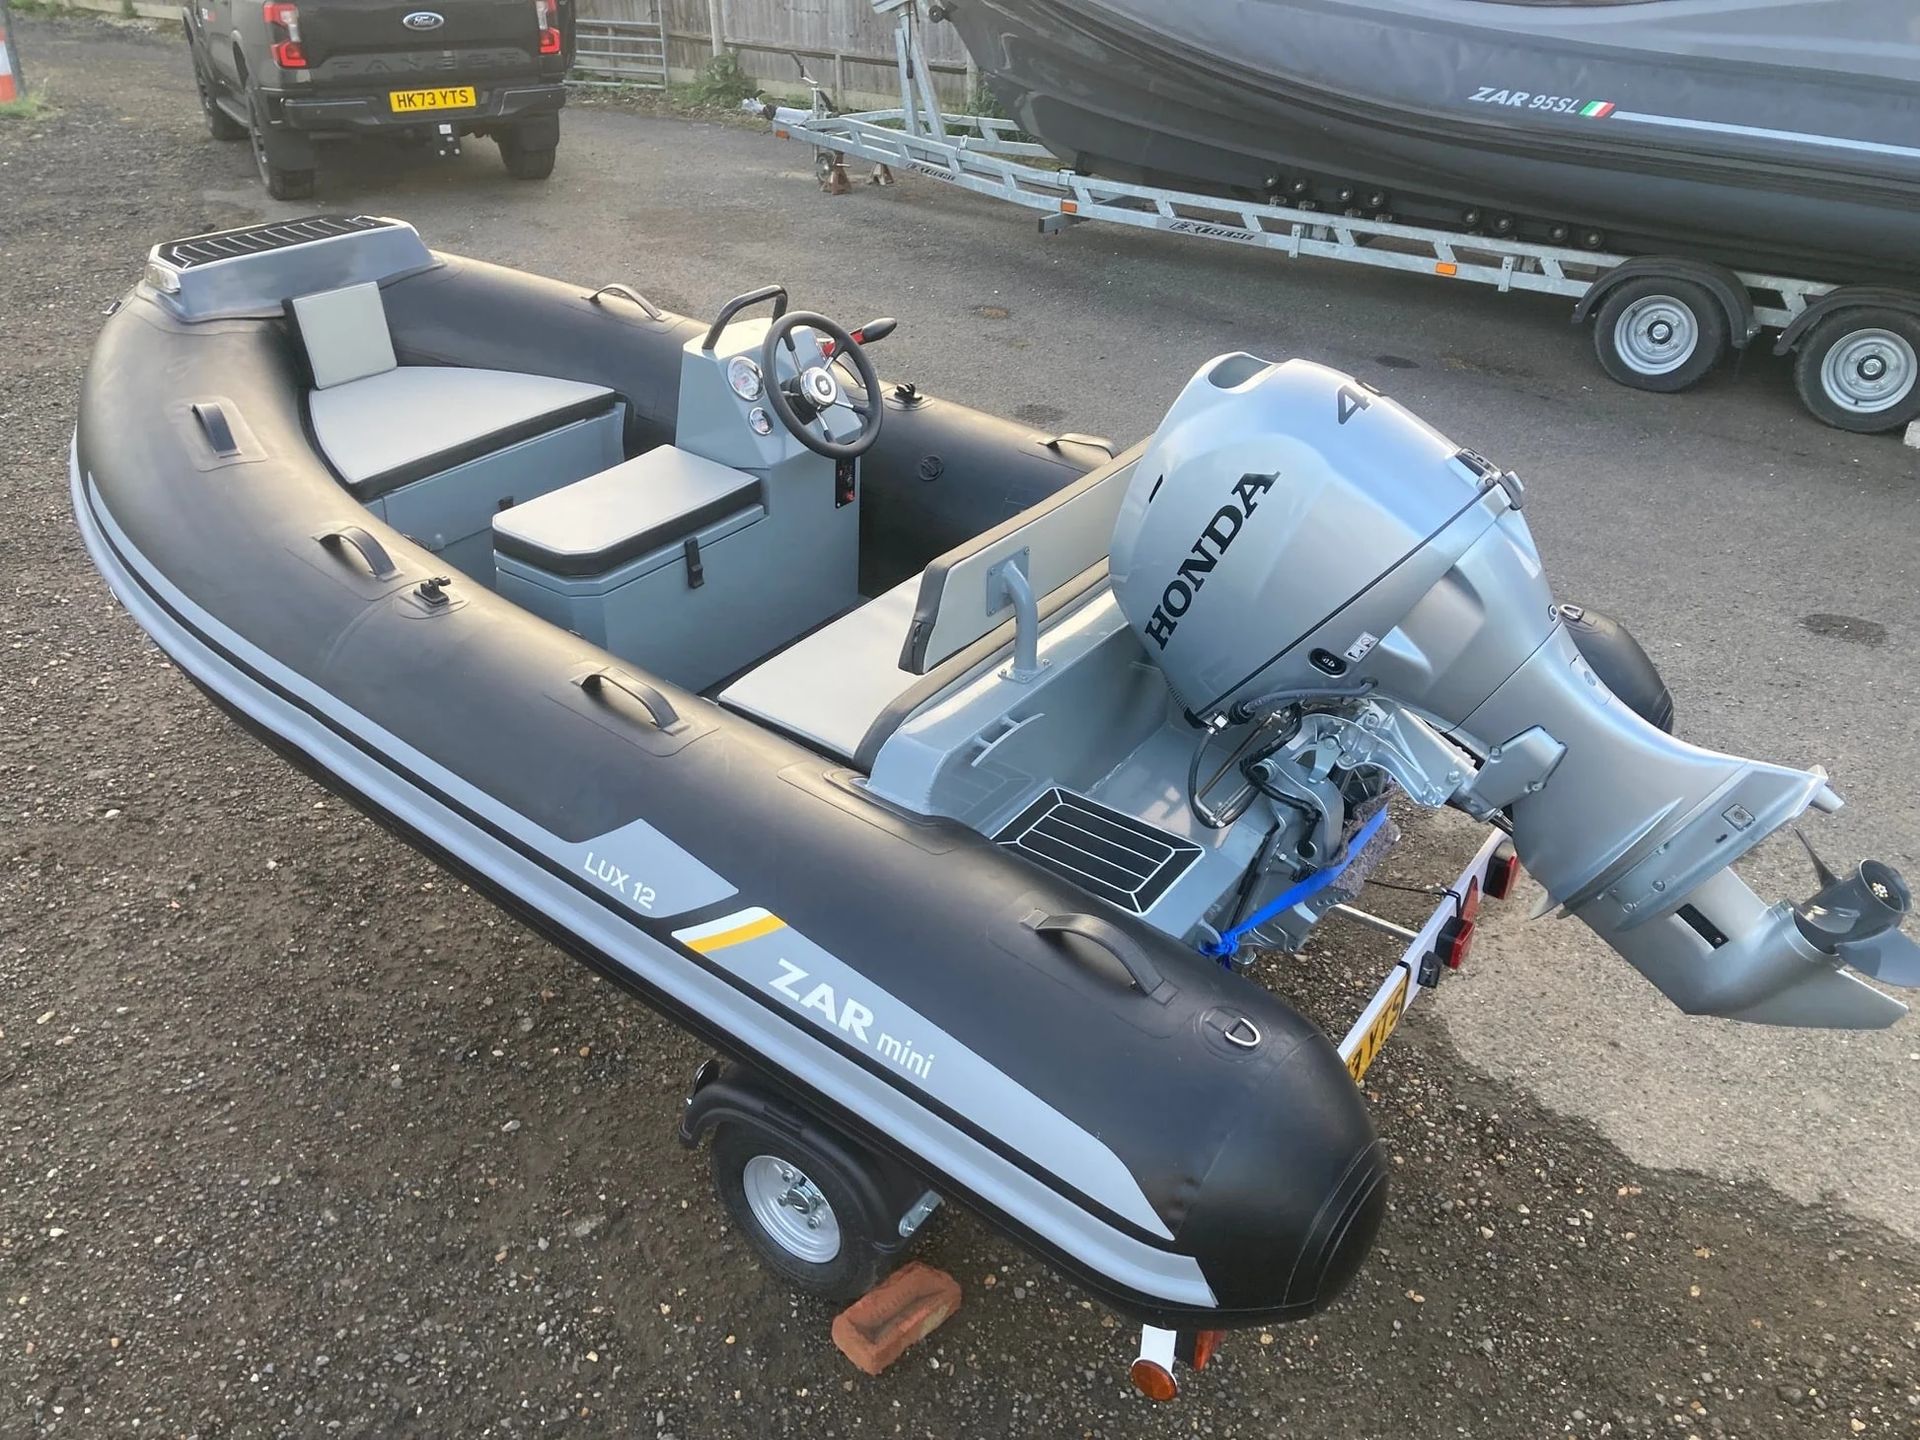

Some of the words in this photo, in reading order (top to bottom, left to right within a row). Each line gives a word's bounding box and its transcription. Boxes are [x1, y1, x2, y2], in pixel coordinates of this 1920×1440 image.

[396, 92, 436, 109] HK73
[439, 89, 469, 105] YTS
[1468, 86, 1530, 107] ZAR
[1528, 94, 1580, 114] 95SL
[1144, 470, 1281, 651] HONDA
[583, 852, 630, 893] LUX
[633, 882, 657, 909] 12
[768, 957, 875, 1045] ZAR
[876, 1032, 936, 1080] mini
